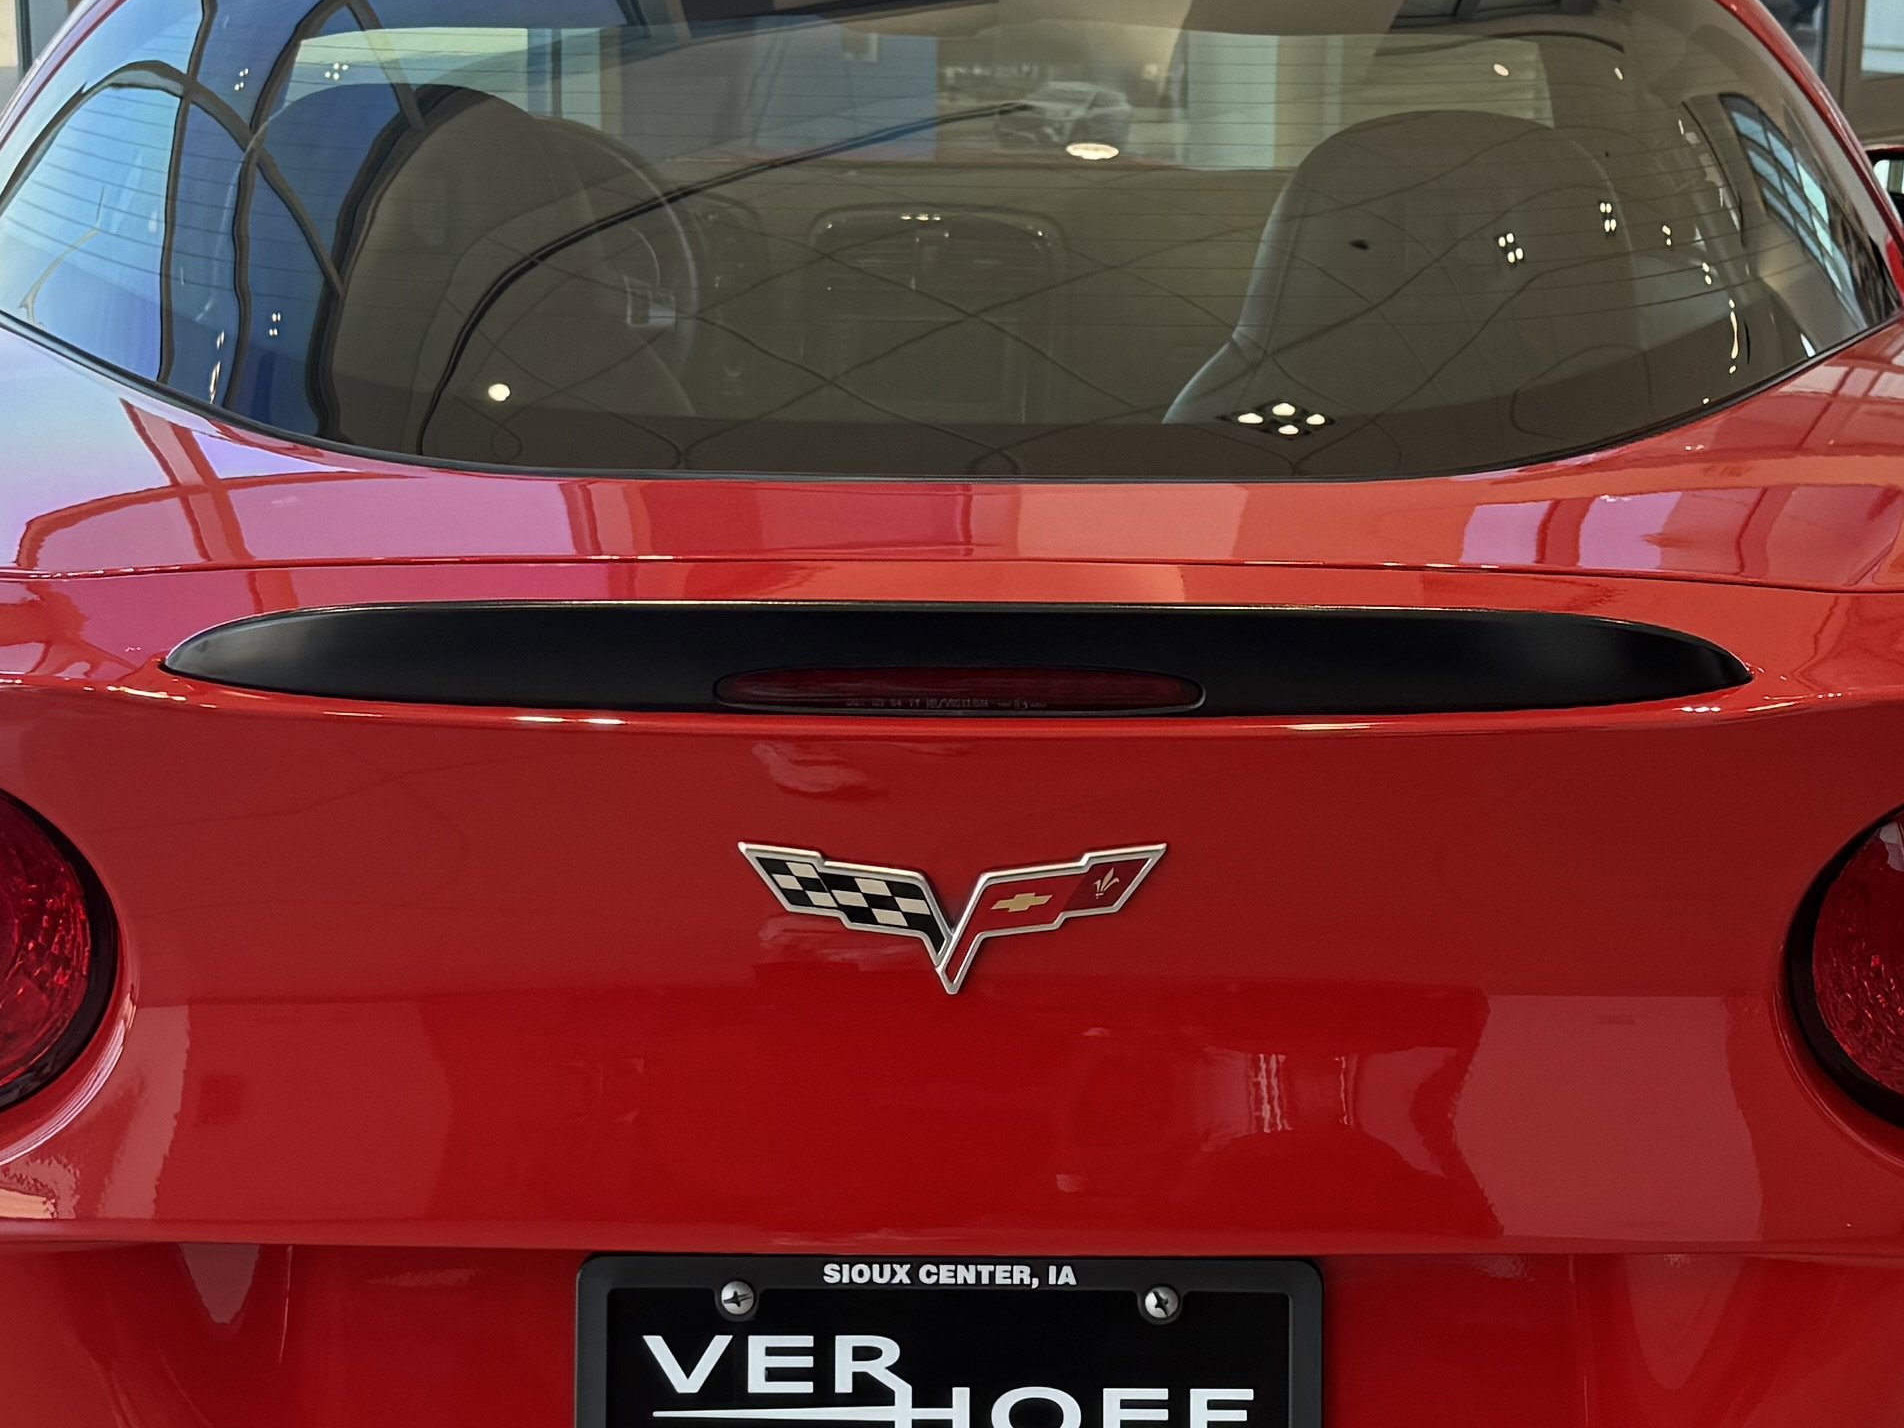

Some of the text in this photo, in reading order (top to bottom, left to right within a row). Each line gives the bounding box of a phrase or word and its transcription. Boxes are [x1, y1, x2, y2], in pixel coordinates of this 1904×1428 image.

[823, 1264, 1077, 1289] SIOUX CENTER, IA
